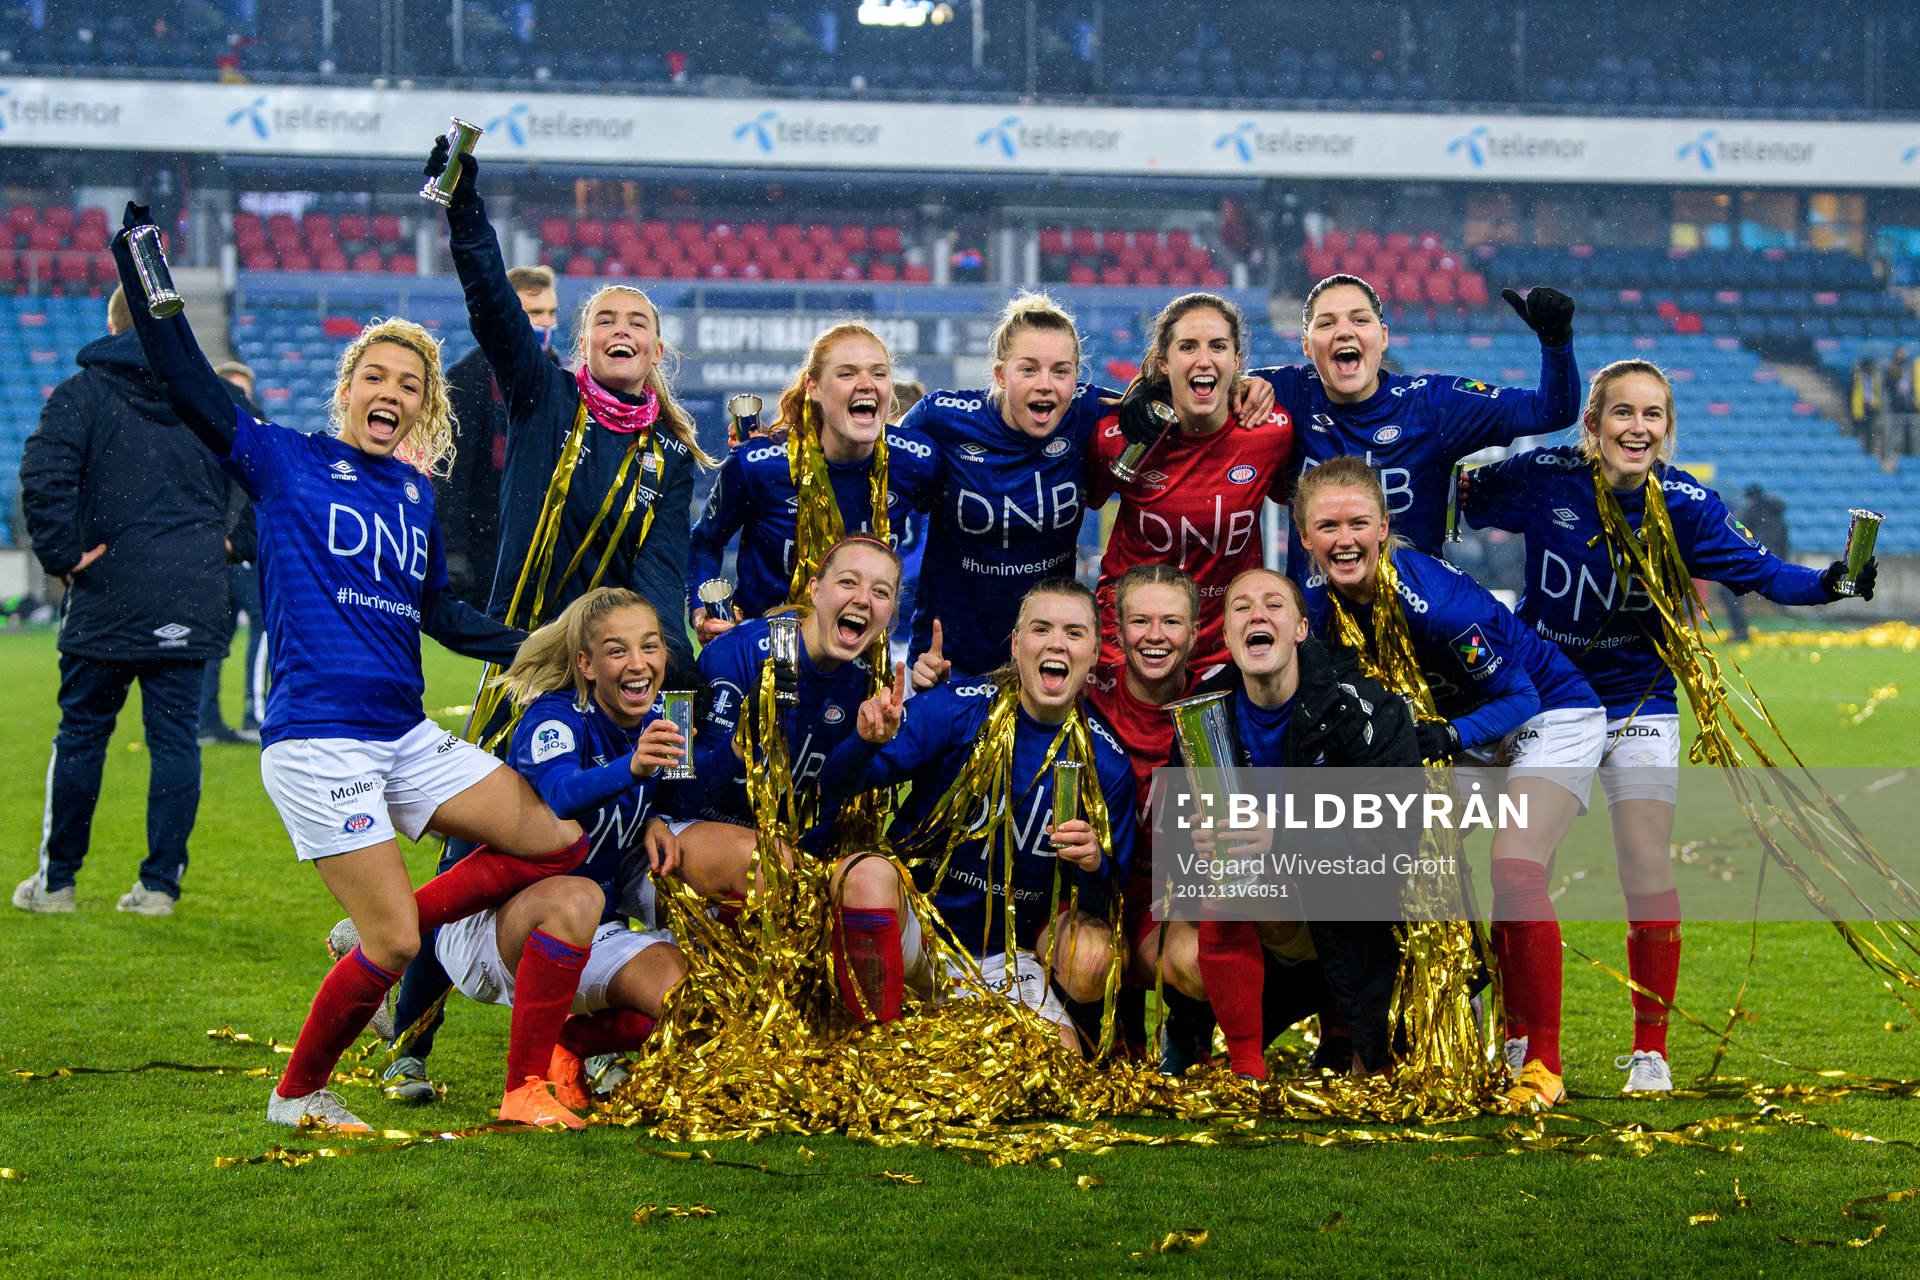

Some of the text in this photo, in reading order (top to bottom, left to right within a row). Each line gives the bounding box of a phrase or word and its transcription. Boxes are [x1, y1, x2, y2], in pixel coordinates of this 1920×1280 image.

[10, 98, 123, 127] telenor
[273, 107, 383, 133] telenor
[527, 112, 635, 139] telenor
[777, 118, 880, 145] telenor
[1018, 124, 1121, 151] telenor
[1254, 128, 1355, 155] telenor
[1487, 133, 1588, 160] telenor
[1717, 137, 1815, 164] telenor
[935, 396, 982, 412] coop
[887, 434, 932, 458] coop
[960, 454, 984, 463] umbro
[331, 473, 357, 482] umbro
[1662, 480, 1706, 501] coop
[958, 471, 1079, 549] DNB
[1139, 495, 1255, 569] DNB
[1552, 519, 1575, 530] umbro
[328, 502, 428, 582] DNB
[1472, 656, 1503, 681] umbro
[956, 683, 999, 698] coop
[537, 740, 567, 757] OBOS
[1088, 717, 1124, 755] coop
